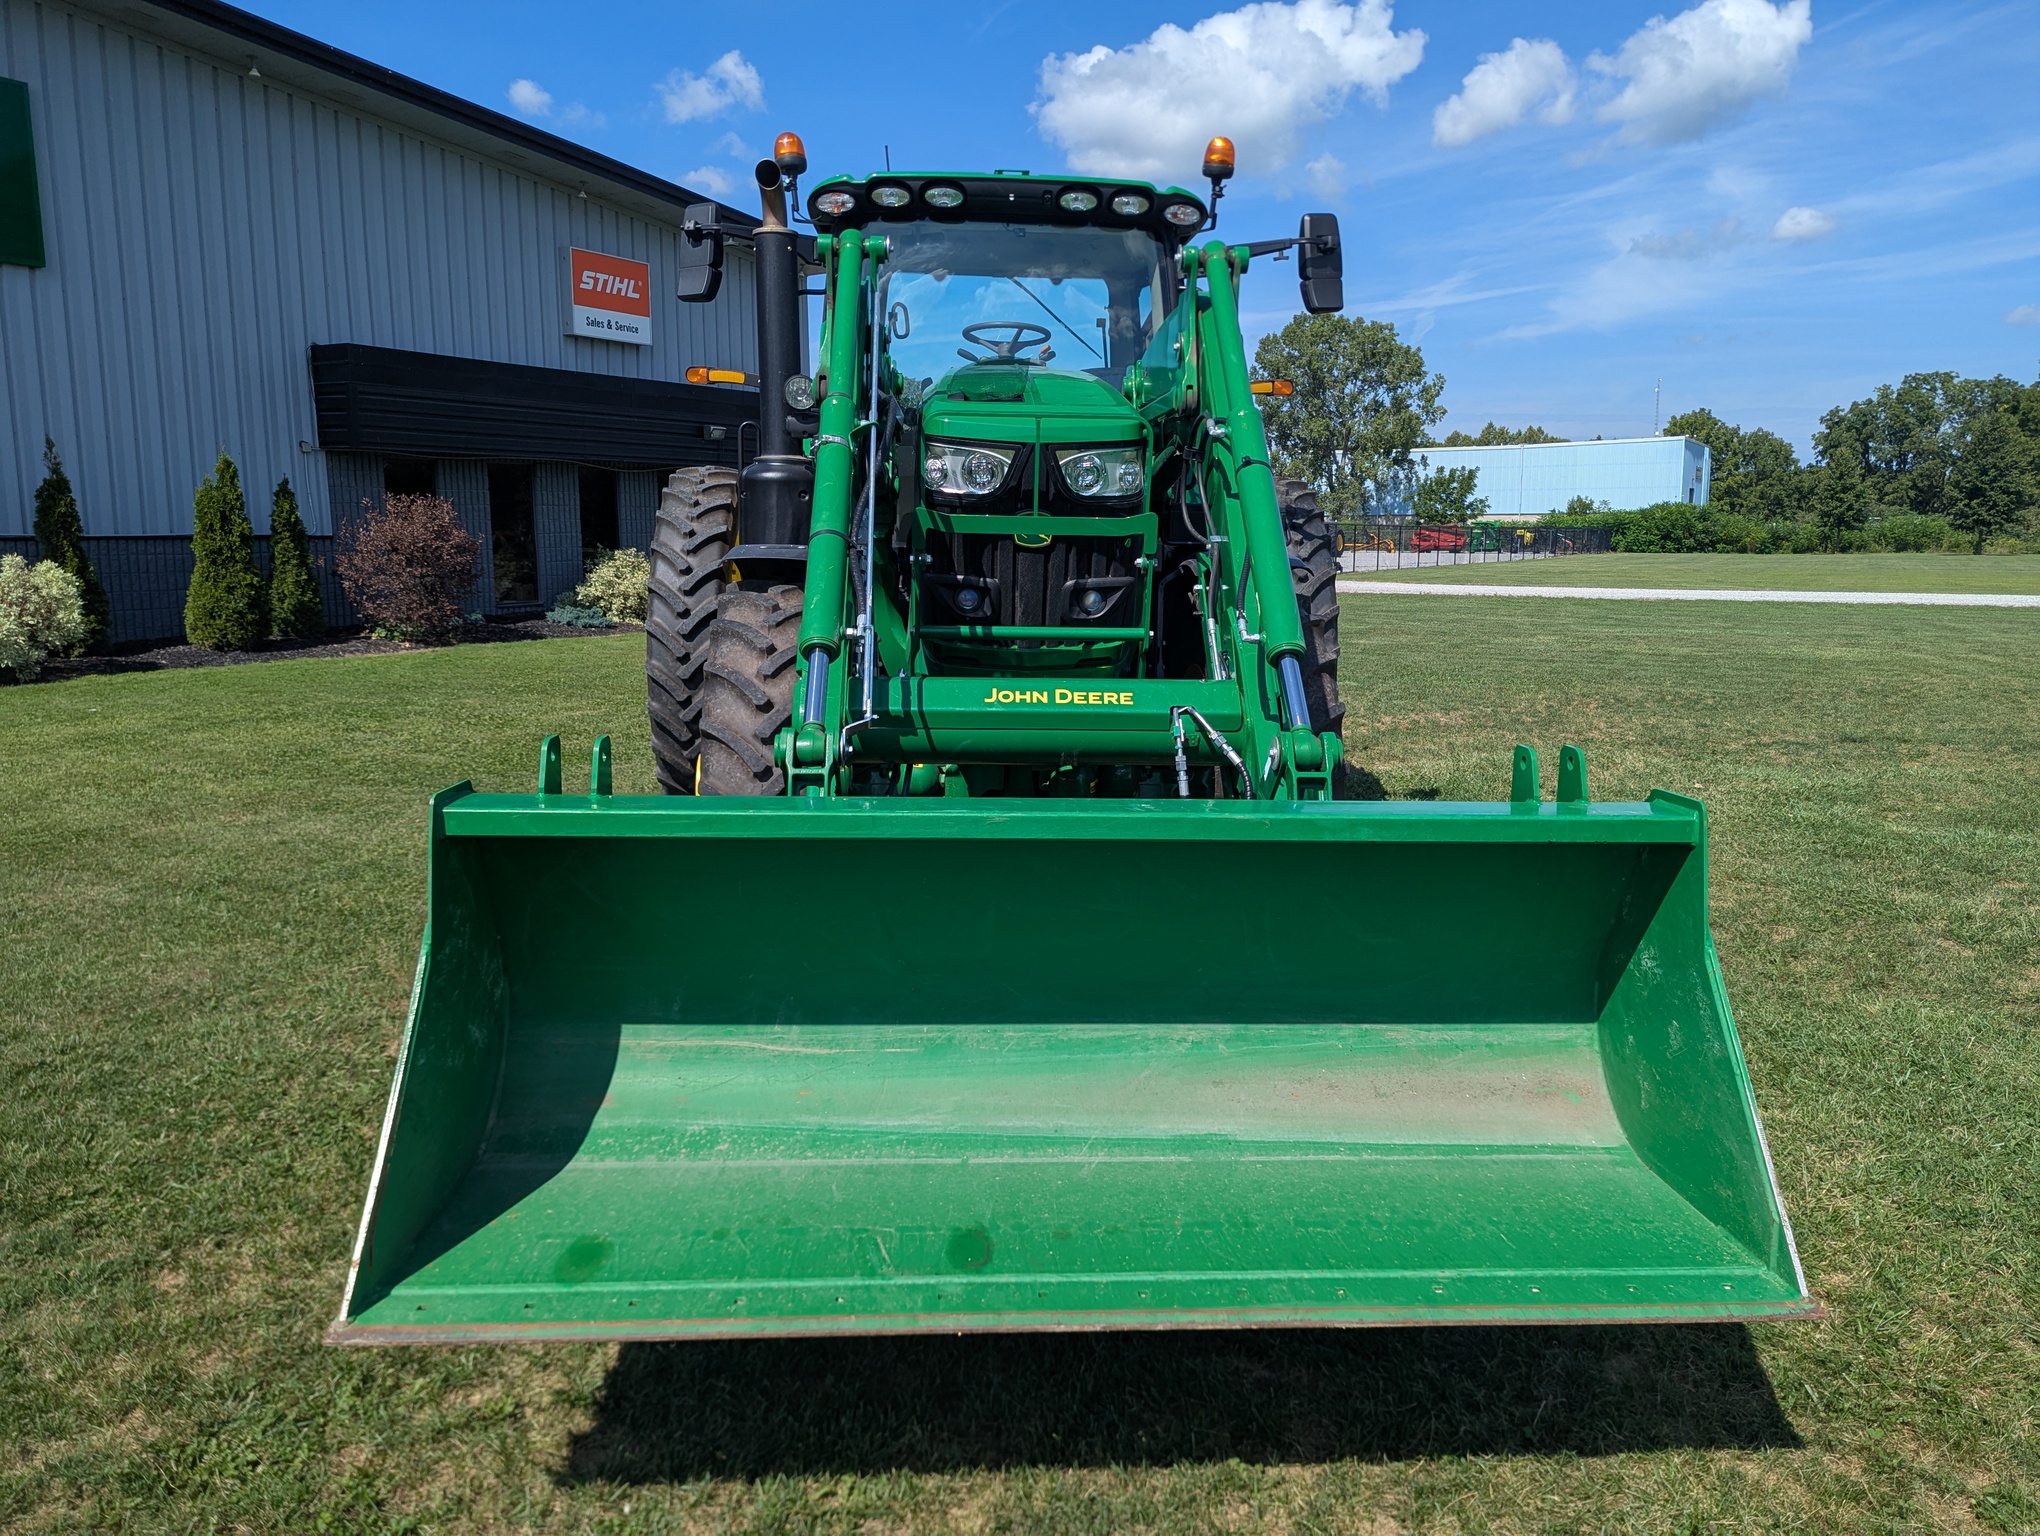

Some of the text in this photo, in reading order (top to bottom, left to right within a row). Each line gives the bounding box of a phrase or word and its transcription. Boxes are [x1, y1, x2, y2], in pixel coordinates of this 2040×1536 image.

[580, 270, 640, 299] STIHL
[586, 316, 639, 334] Sales & Service
[984, 688, 1134, 705] JOHN DEERE
